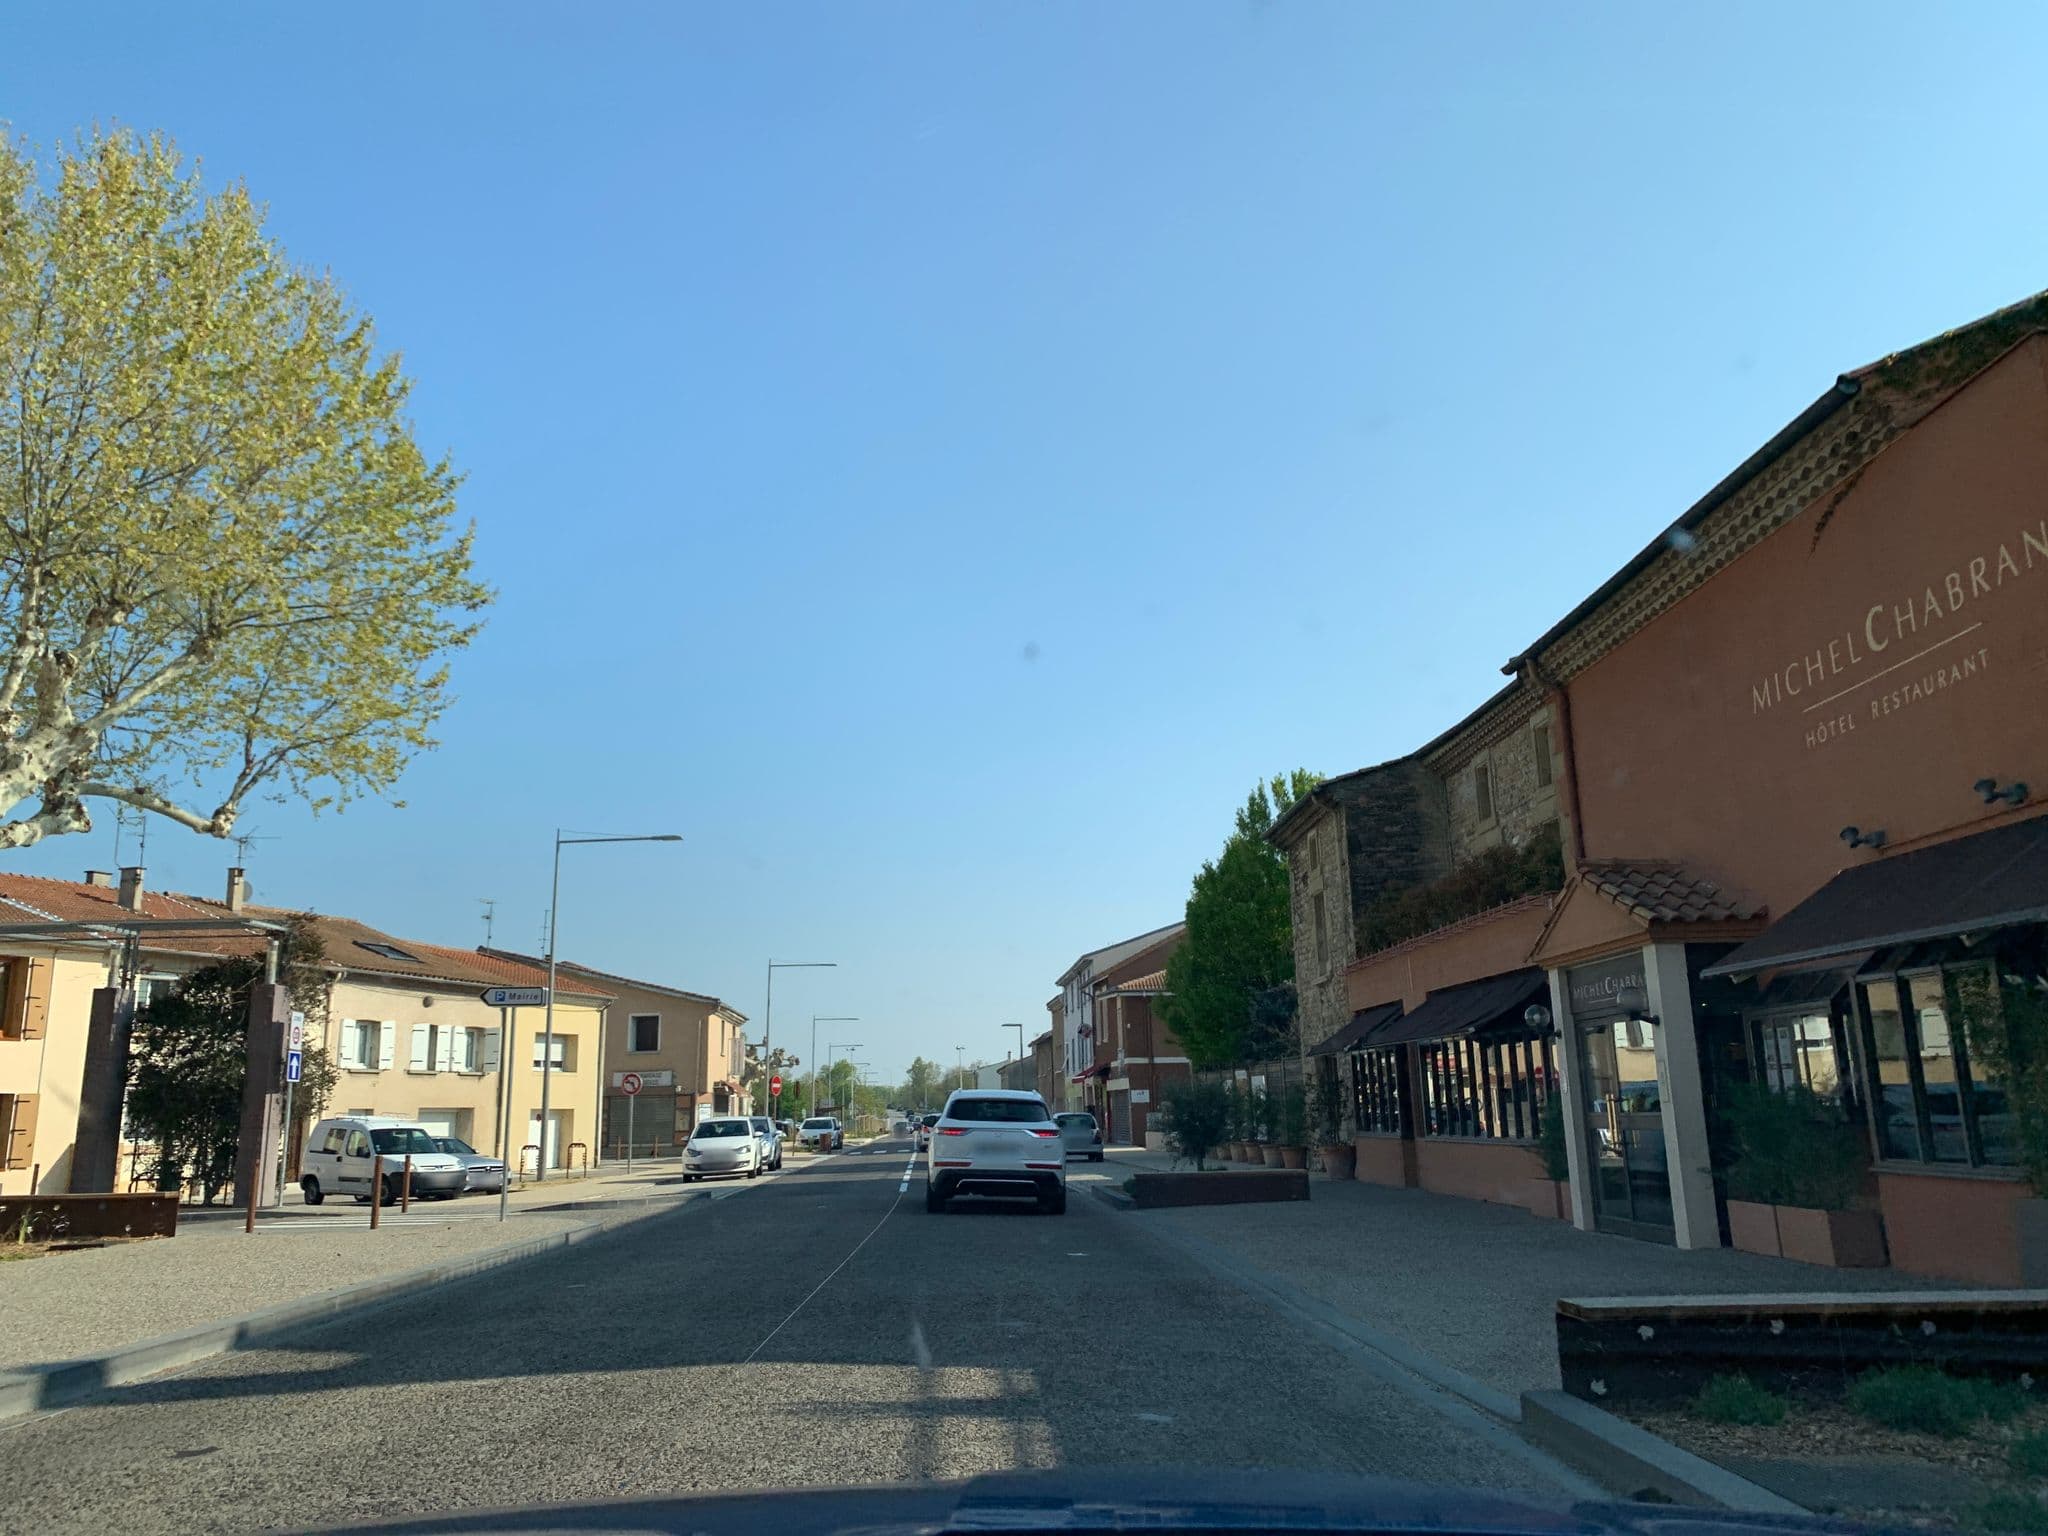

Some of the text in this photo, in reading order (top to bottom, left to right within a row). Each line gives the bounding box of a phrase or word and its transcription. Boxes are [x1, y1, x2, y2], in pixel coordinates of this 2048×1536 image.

[1751, 632, 1863, 715] MICHEL
[1805, 648, 1989, 750] HÔTEL RESTAURANT
